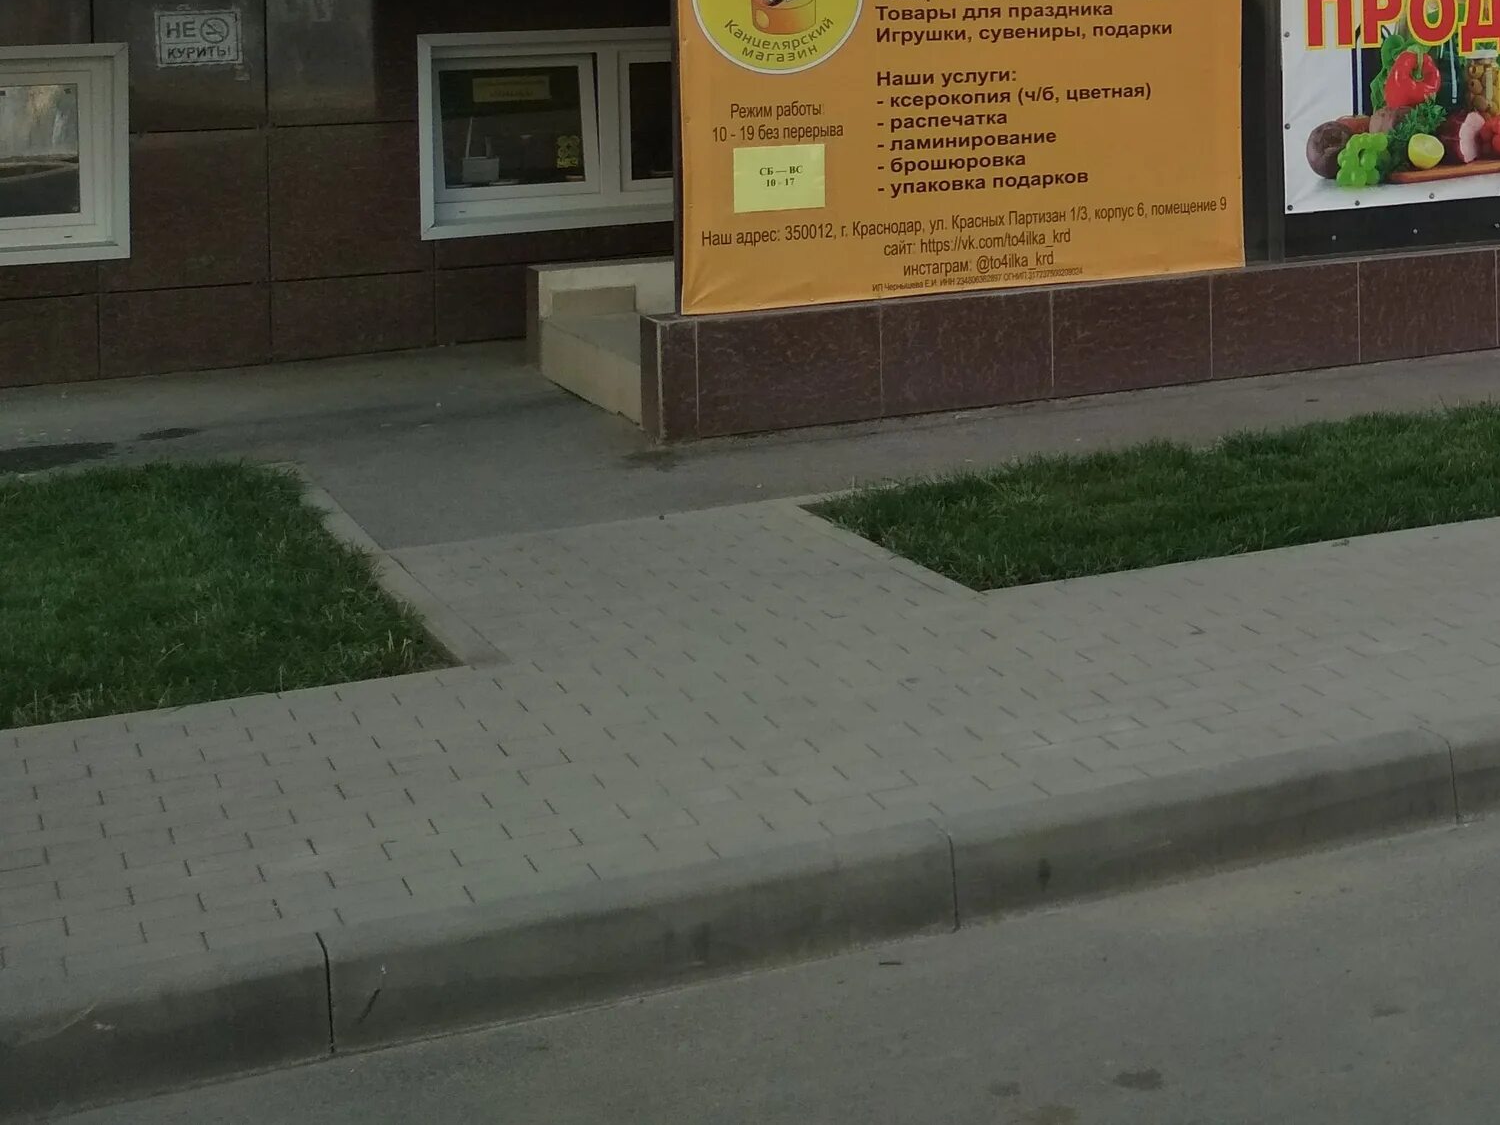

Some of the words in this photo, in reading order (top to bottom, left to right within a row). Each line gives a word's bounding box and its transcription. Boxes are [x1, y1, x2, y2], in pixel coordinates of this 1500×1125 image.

[874, 5, 957, 24] Товары
[962, 5, 1001, 22] для
[1008, 2, 1113, 21] праздника
[166, 20, 196, 39] НЕ
[725, 17, 834, 50] Канцелярский
[875, 25, 973, 45] Игрушки,
[978, 24, 1087, 43] сувениры,
[1092, 21, 1173, 40] подарки
[742, 44, 818, 63] магазин
[876, 70, 935, 87] Наши
[941, 68, 1017, 88] услуги:
[890, 90, 1011, 109] ксерокопия
[1017, 86, 1060, 106] (ч/б,
[1066, 82, 1151, 102] цветная)
[730, 103, 773, 119] Режим
[890, 111, 1008, 133] распечатка
[712, 126, 728, 142] 10
[740, 125, 755, 141] 19
[758, 124, 780, 140] без
[783, 124, 844, 142] перерыва
[889, 130, 1057, 152] ламинирование
[759, 166, 774, 176] СБ
[789, 165, 804, 175] ВС
[890, 152, 1026, 176] брошюровка
[766, 178, 776, 187] 10
[785, 177, 795, 186] 17
[890, 176, 986, 199] упаковка
[992, 171, 1089, 190] подарков
[701, 230, 733, 247] Наш
[736, 228, 781, 250] адрес:
[784, 223, 837, 242] 350012,
[841, 225, 849, 238] г.
[852, 218, 926, 241] Краснодар,
[929, 217, 948, 234] ул.
[951, 212, 1006, 231] Красных
[1008, 207, 1067, 228] Партизан
[1070, 205, 1092, 222] 1/3,
[1094, 203, 1135, 223] корпус
[1136, 202, 1148, 219] 6,
[1151, 199, 1217, 218] помещение
[1219, 196, 1228, 211] 9
[920, 228, 1071, 256] https://vk.com/to4ilka_krd
[976, 251, 1055, 274] @to4ilka_krd
